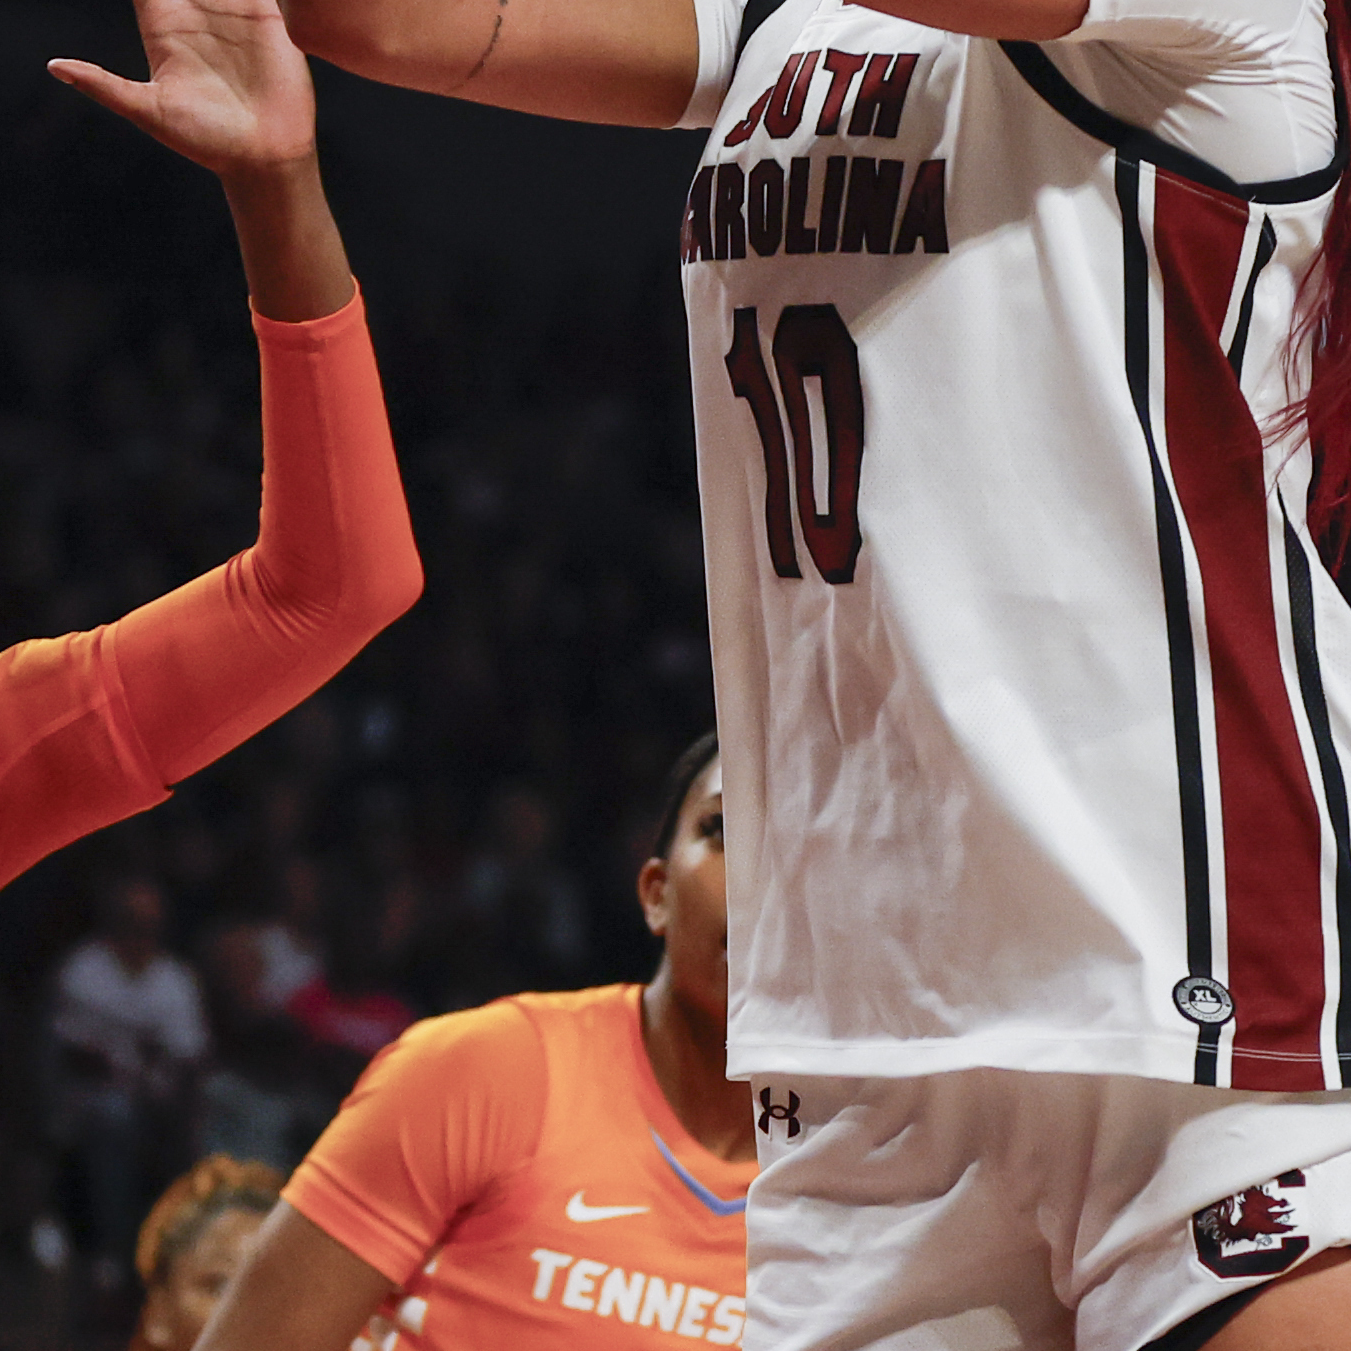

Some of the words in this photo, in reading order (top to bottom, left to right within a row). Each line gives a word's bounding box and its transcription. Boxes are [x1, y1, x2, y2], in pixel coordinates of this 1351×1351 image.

[680, 156, 949, 265] AROLINA
[724, 303, 864, 584] 10
[1193, 989, 1218, 1002] XL
[530, 1248, 746, 1347] TENNES
